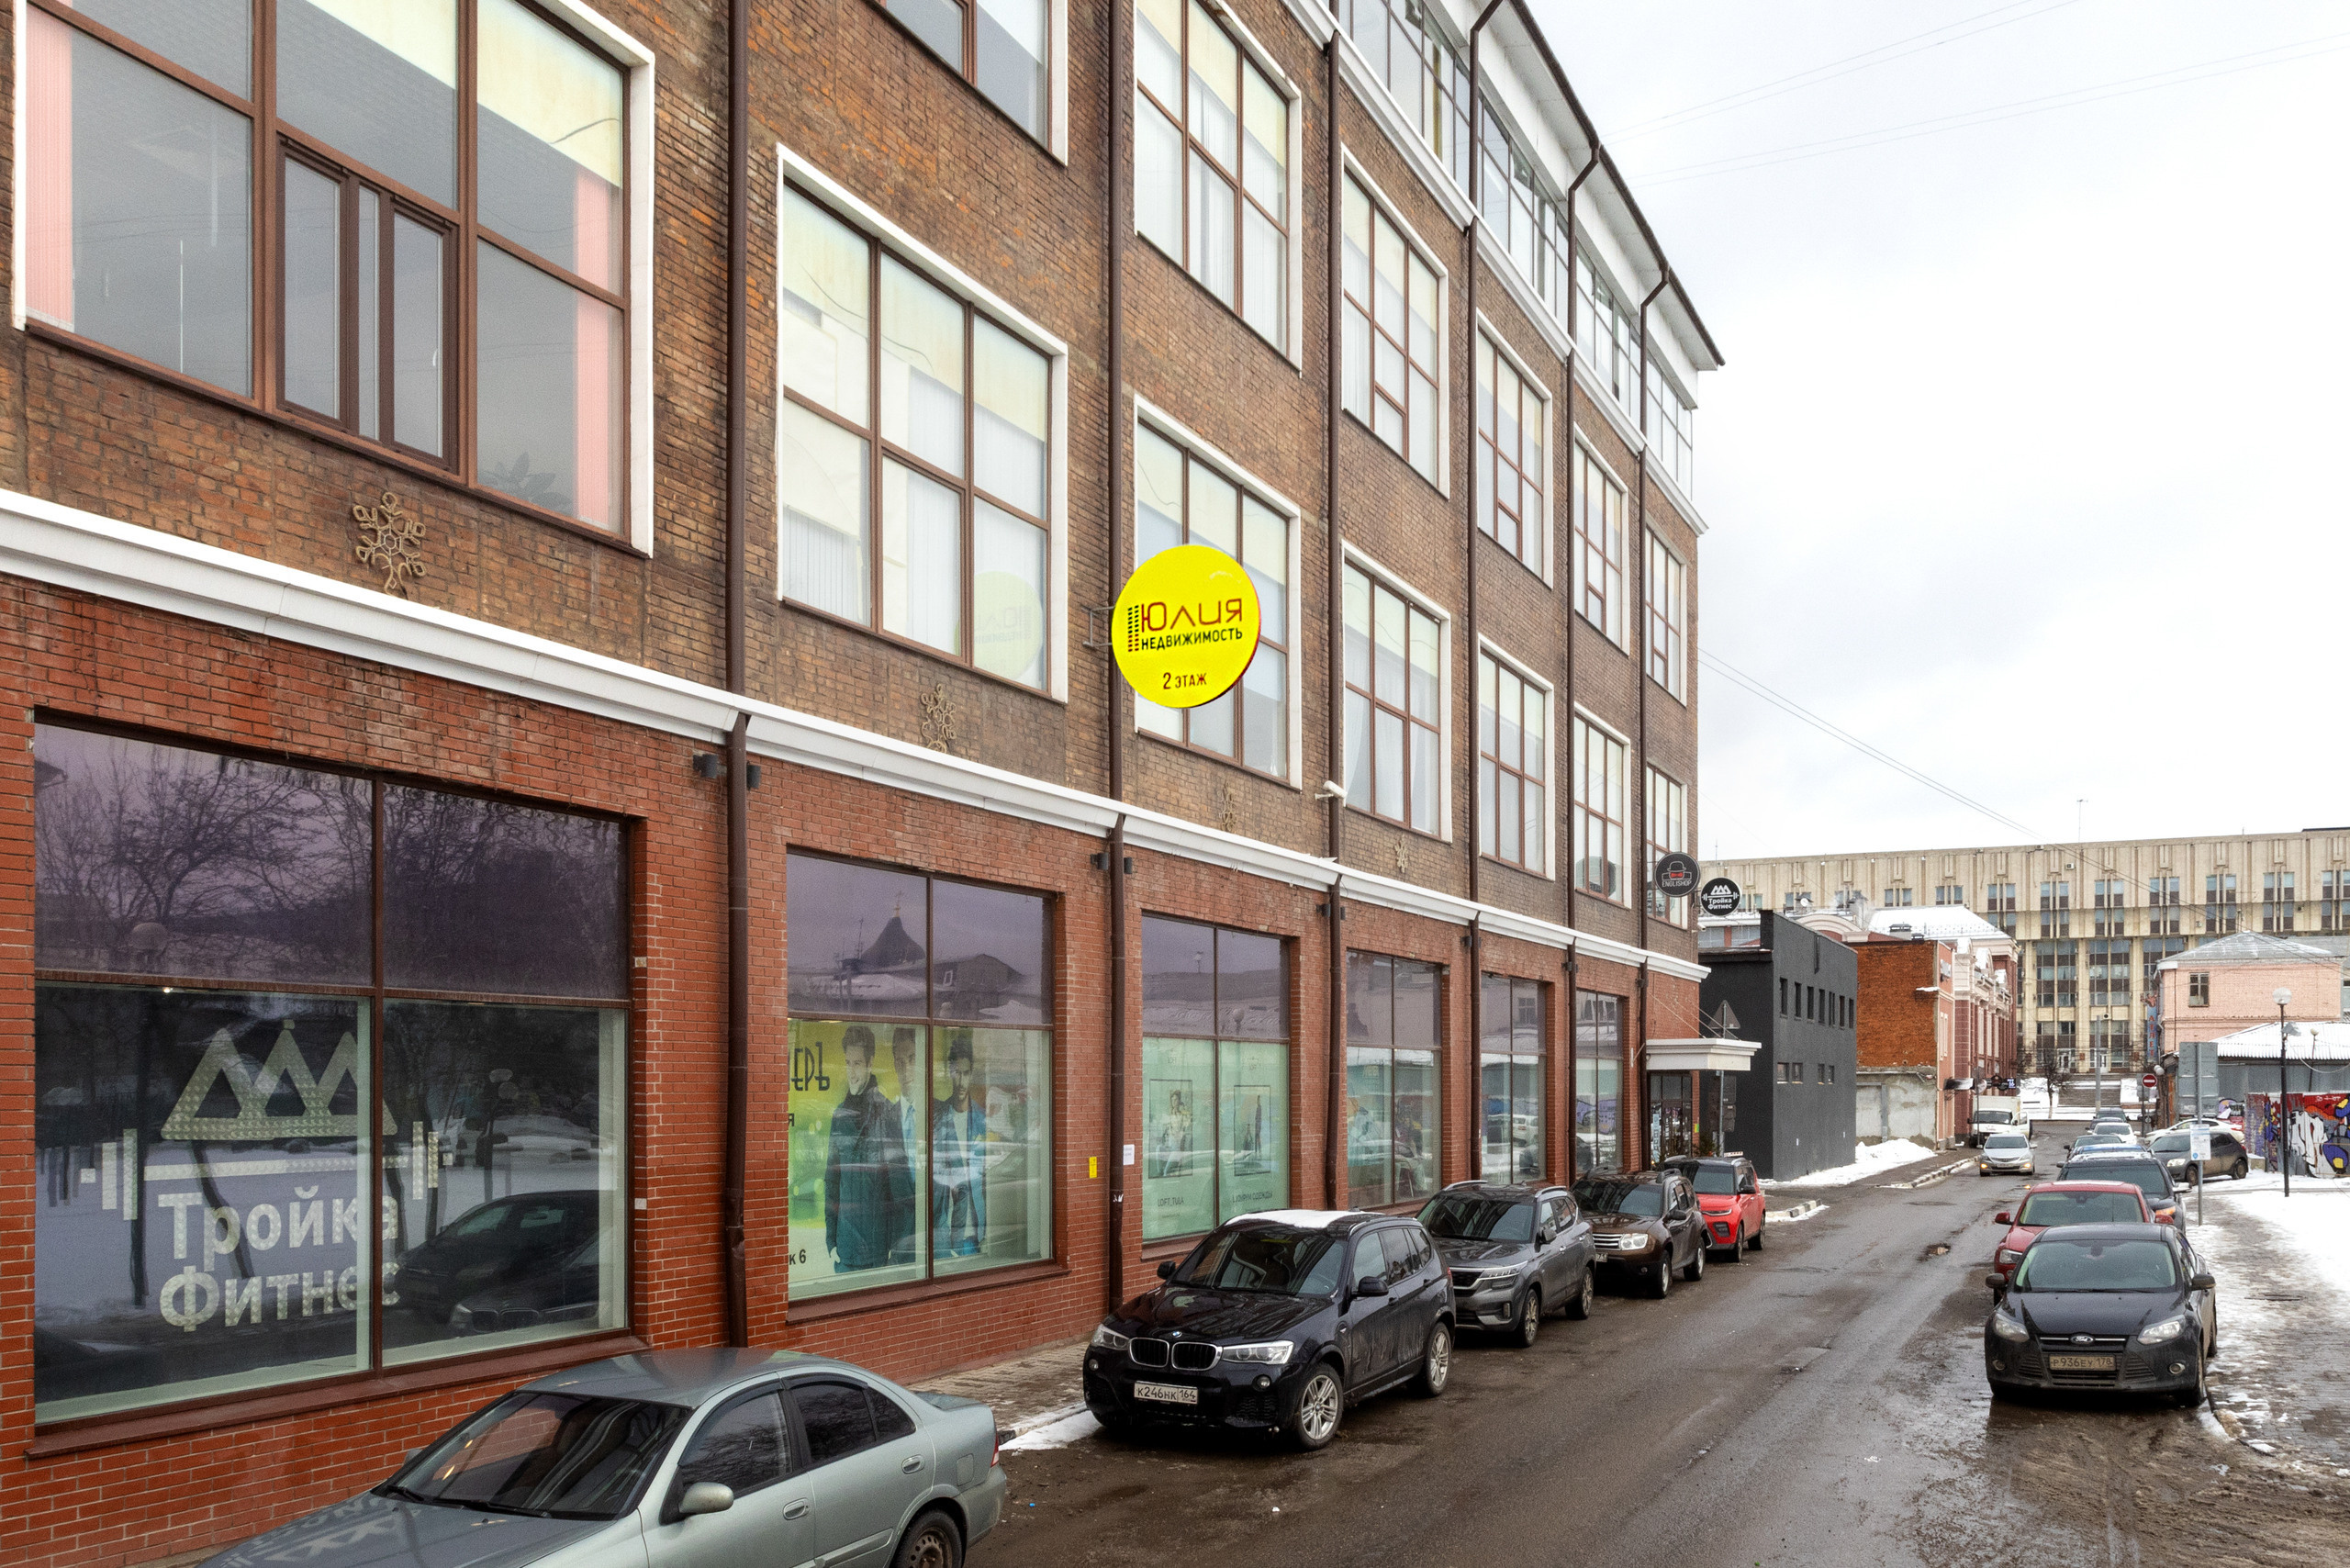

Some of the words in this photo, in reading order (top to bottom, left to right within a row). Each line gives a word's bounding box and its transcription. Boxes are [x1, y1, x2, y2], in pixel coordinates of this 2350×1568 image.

[1141, 598, 1242, 633] ЮЛИЯ
[1141, 627, 1243, 651] НЕДВИЖИМОСТЬ
[1162, 672, 1171, 689] 2
[1175, 673, 1207, 688] ЭТАЖ
[788, 1041, 830, 1092] ЕРЪ
[158, 1185, 399, 1271] Тройка
[800, 1249, 806, 1264] 6
[159, 1261, 401, 1332] Фитнес
[1137, 1386, 1177, 1400] К246НК
[1180, 1389, 1196, 1400] 164
